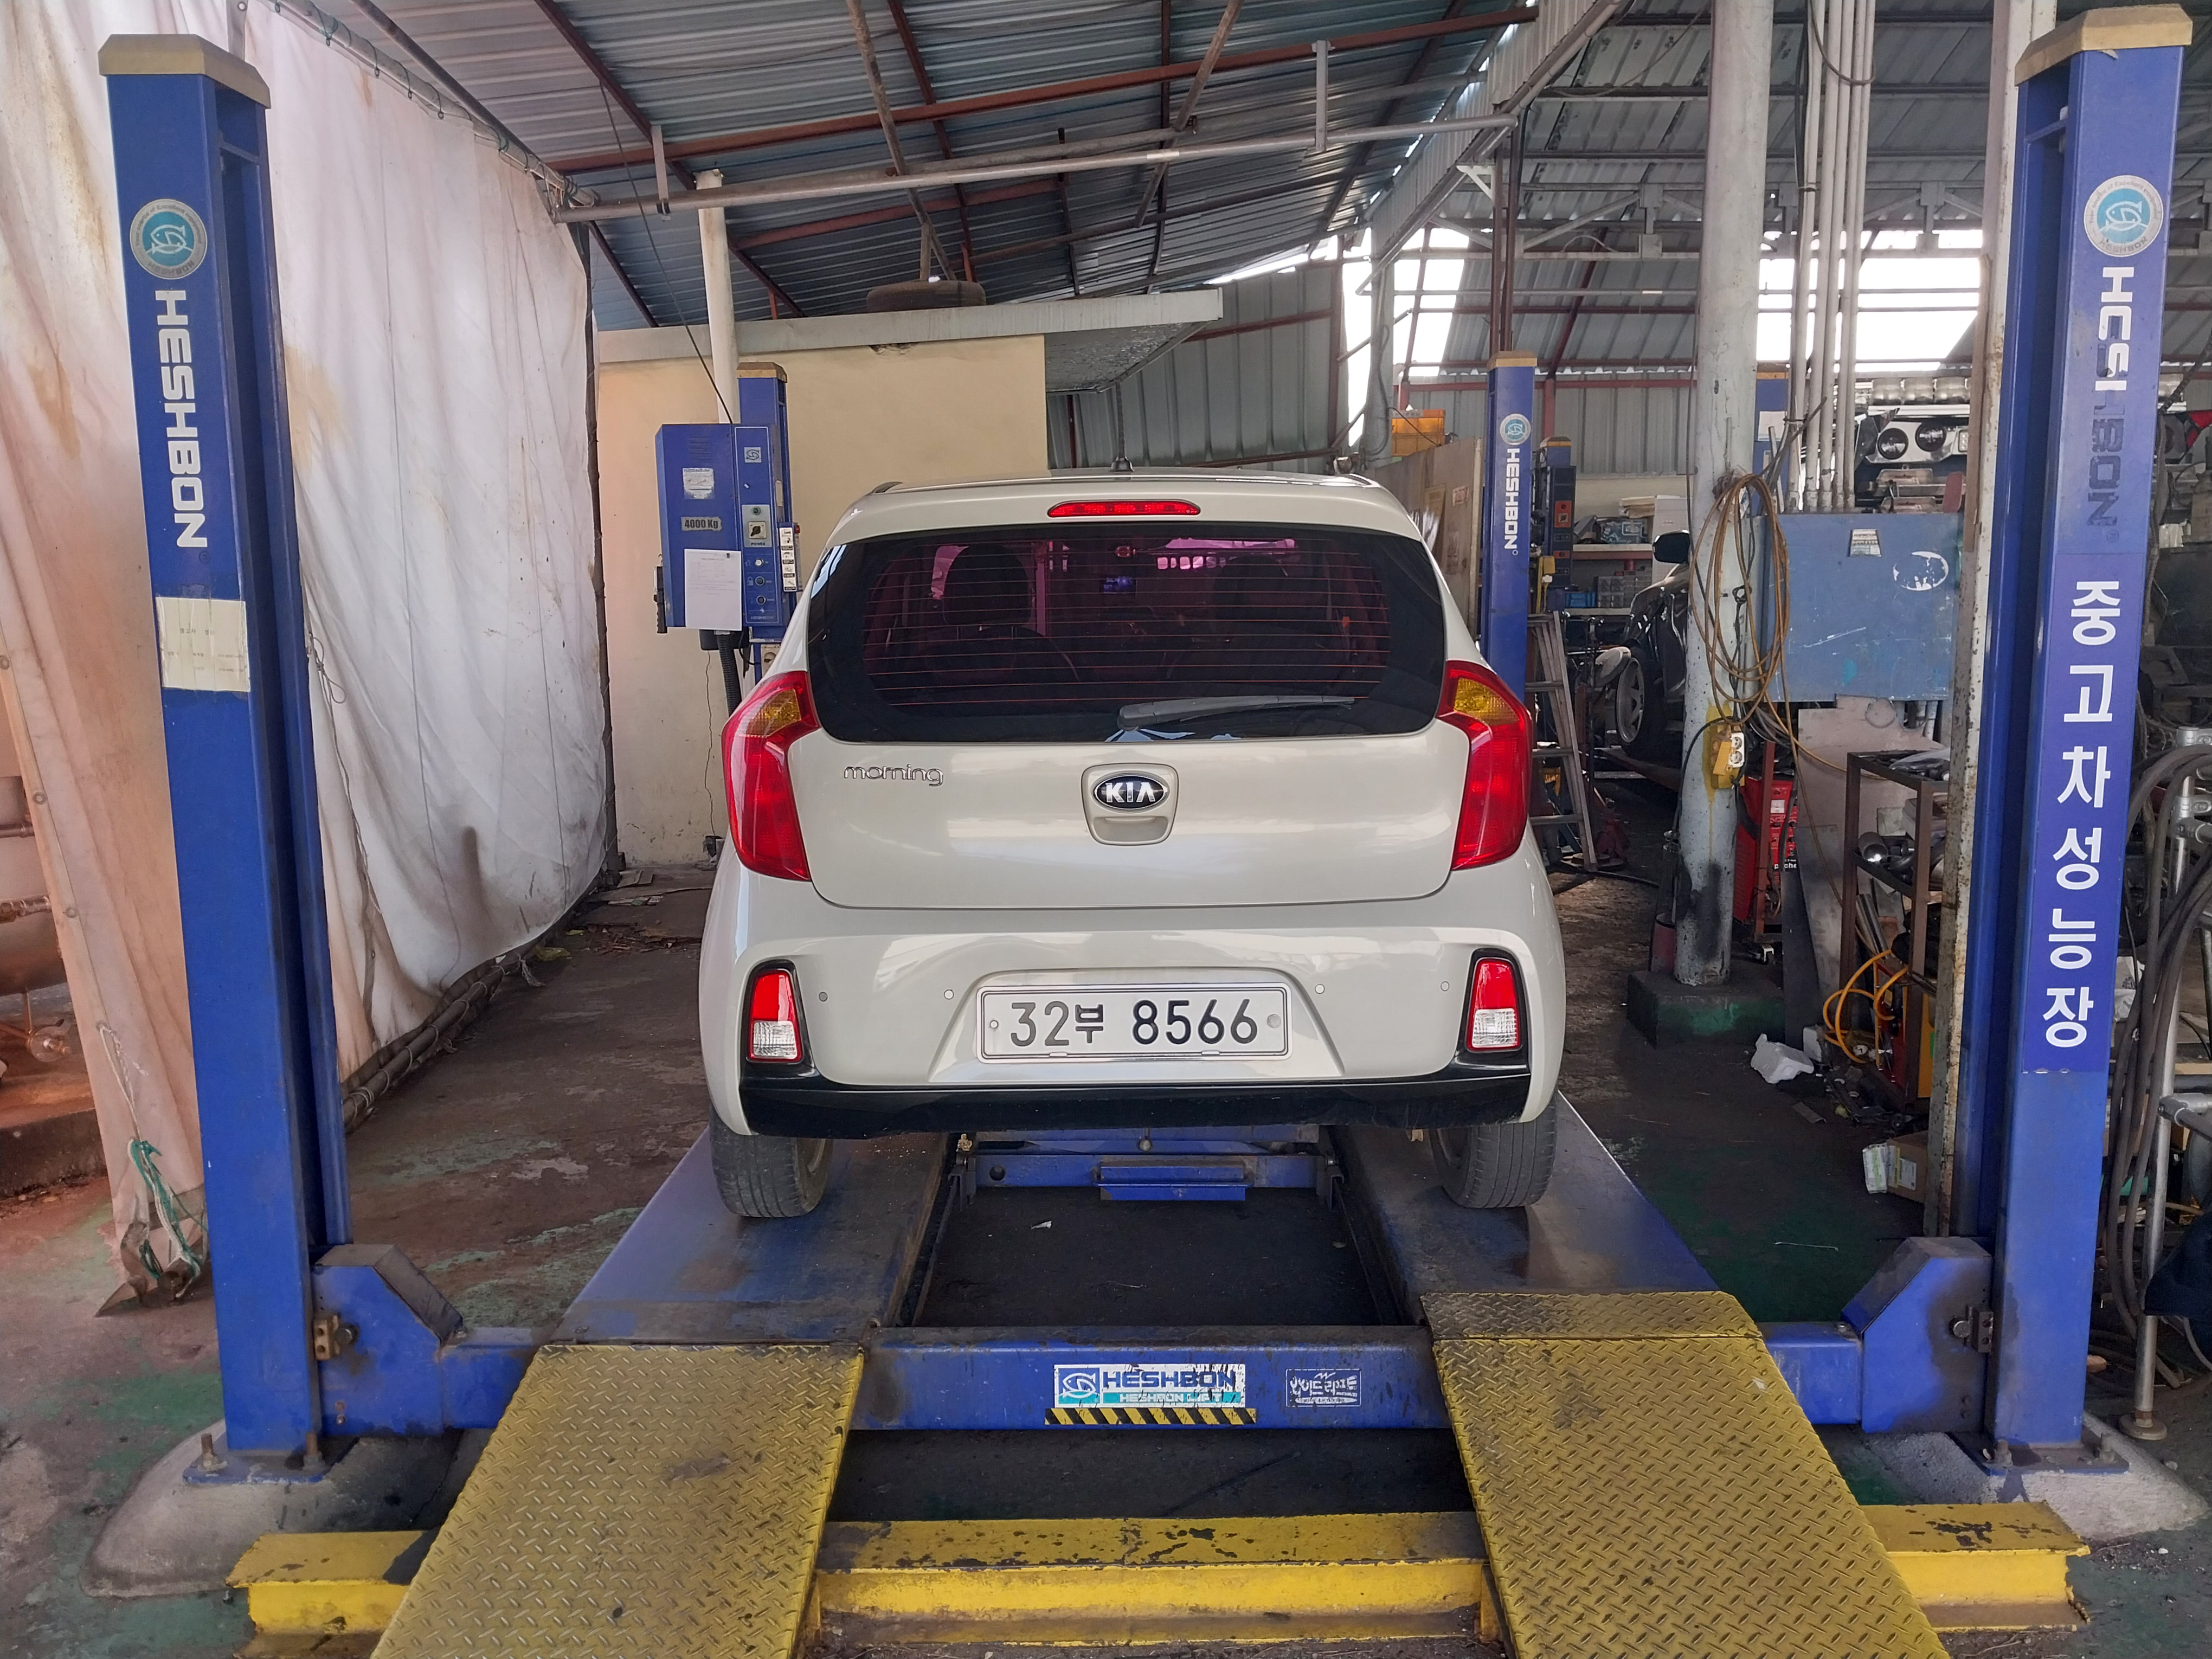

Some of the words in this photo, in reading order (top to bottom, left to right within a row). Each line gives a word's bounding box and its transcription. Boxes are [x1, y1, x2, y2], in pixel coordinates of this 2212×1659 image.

[157, 204, 185, 214] Excellent
[2099, 236, 2148, 253] HESHBON
[148, 260, 195, 275] HESHBON
[155, 290, 208, 548] HESHBON
[1504, 448, 1520, 549] HESHBON
[685, 519, 706, 529] 4000
[708, 519, 718, 529] Kg
[844, 764, 944, 787] morning
[1104, 782, 1157, 803] KIA
[1010, 1000, 1104, 1047] 32부
[1132, 999, 1258, 1045] 8566
[1103, 1370, 1236, 1388] HESHBON
[1120, 1393, 1184, 1403] HESHBON
